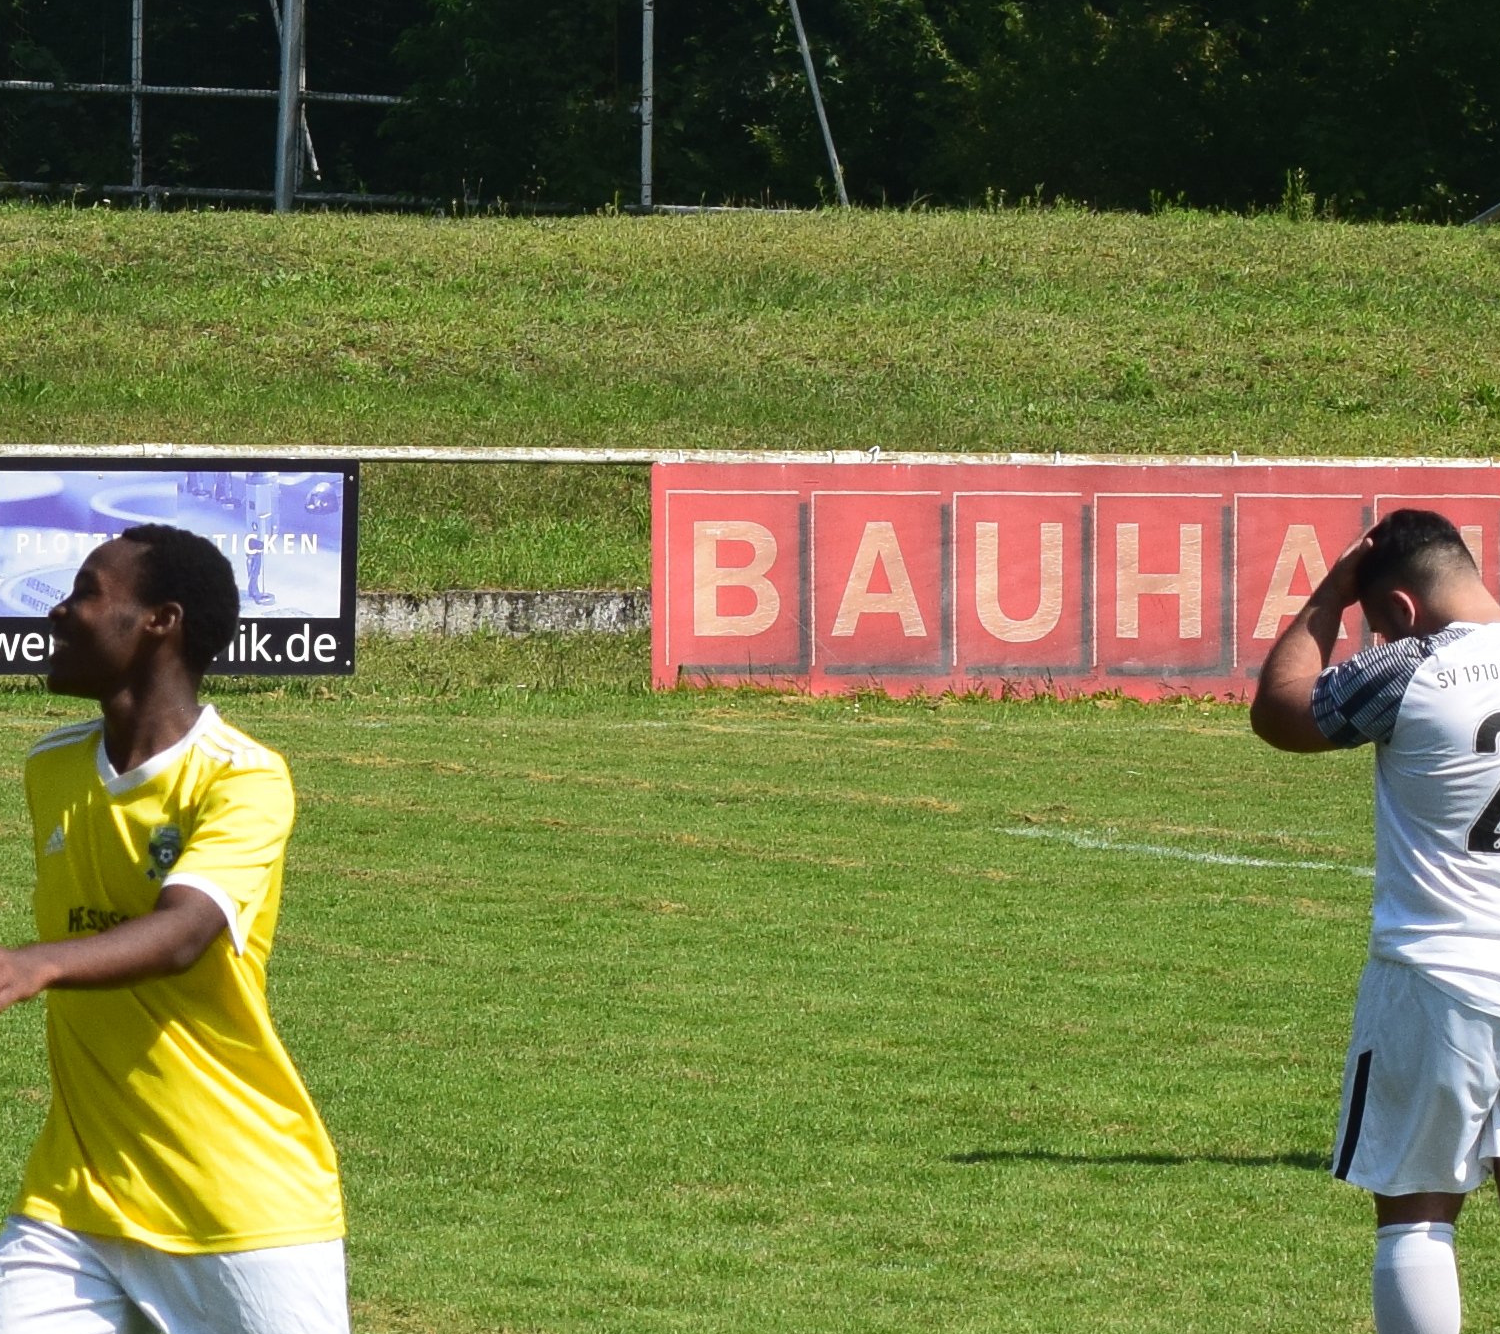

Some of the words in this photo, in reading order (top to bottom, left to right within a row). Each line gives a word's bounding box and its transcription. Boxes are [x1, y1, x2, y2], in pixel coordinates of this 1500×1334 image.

[16, 533, 122, 555] PLOTT
[199, 533, 318, 555] TICKEN
[1436, 669, 1458, 690] SV
[1462, 663, 1500, 684] 1910
